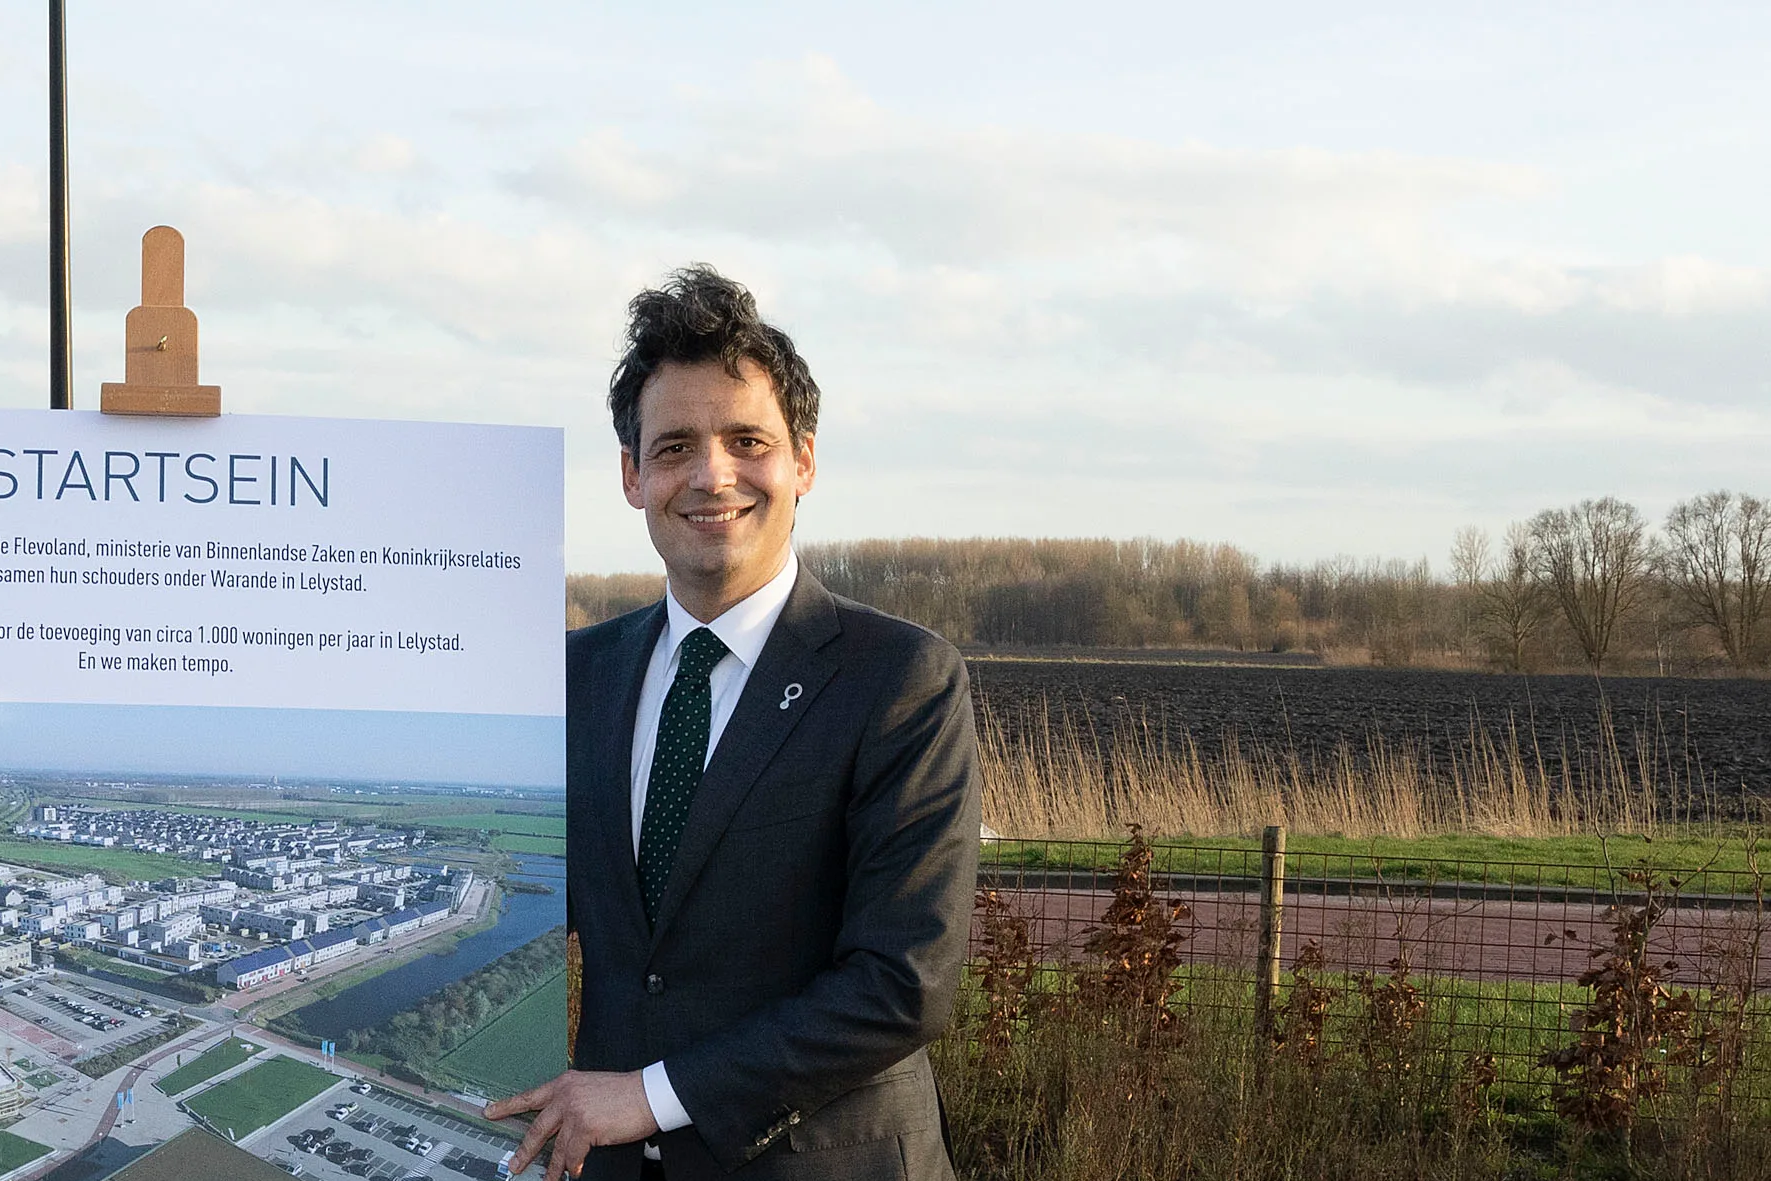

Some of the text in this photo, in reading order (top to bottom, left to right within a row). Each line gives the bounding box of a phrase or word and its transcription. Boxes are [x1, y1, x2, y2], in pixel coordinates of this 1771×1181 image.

[14, 536, 91, 559] Flevoland,
[95, 538, 171, 558] ministerie
[175, 544, 201, 559] van
[206, 541, 307, 562] Binnenlandse
[311, 544, 355, 564] Zaken
[360, 550, 377, 565] en
[382, 546, 521, 571] Koninkrijksrelaties
[50, 565, 78, 585] hun
[82, 566, 160, 586] schouders
[164, 568, 207, 587] onder
[210, 569, 277, 589] Warande
[282, 571, 295, 590] in
[300, 571, 367, 596] Lelystad.
[16, 621, 35, 640] de
[39, 623, 121, 647] toevoeging
[125, 628, 152, 643] van
[156, 624, 193, 644] circa
[197, 625, 239, 646] 1.000
[242, 627, 315, 651] woningen
[319, 632, 343, 652] per
[345, 629, 377, 652] jaar
[379, 630, 393, 649] in
[398, 631, 465, 655] Lelystad.
[78, 651, 234, 677] En we maken tempo.
